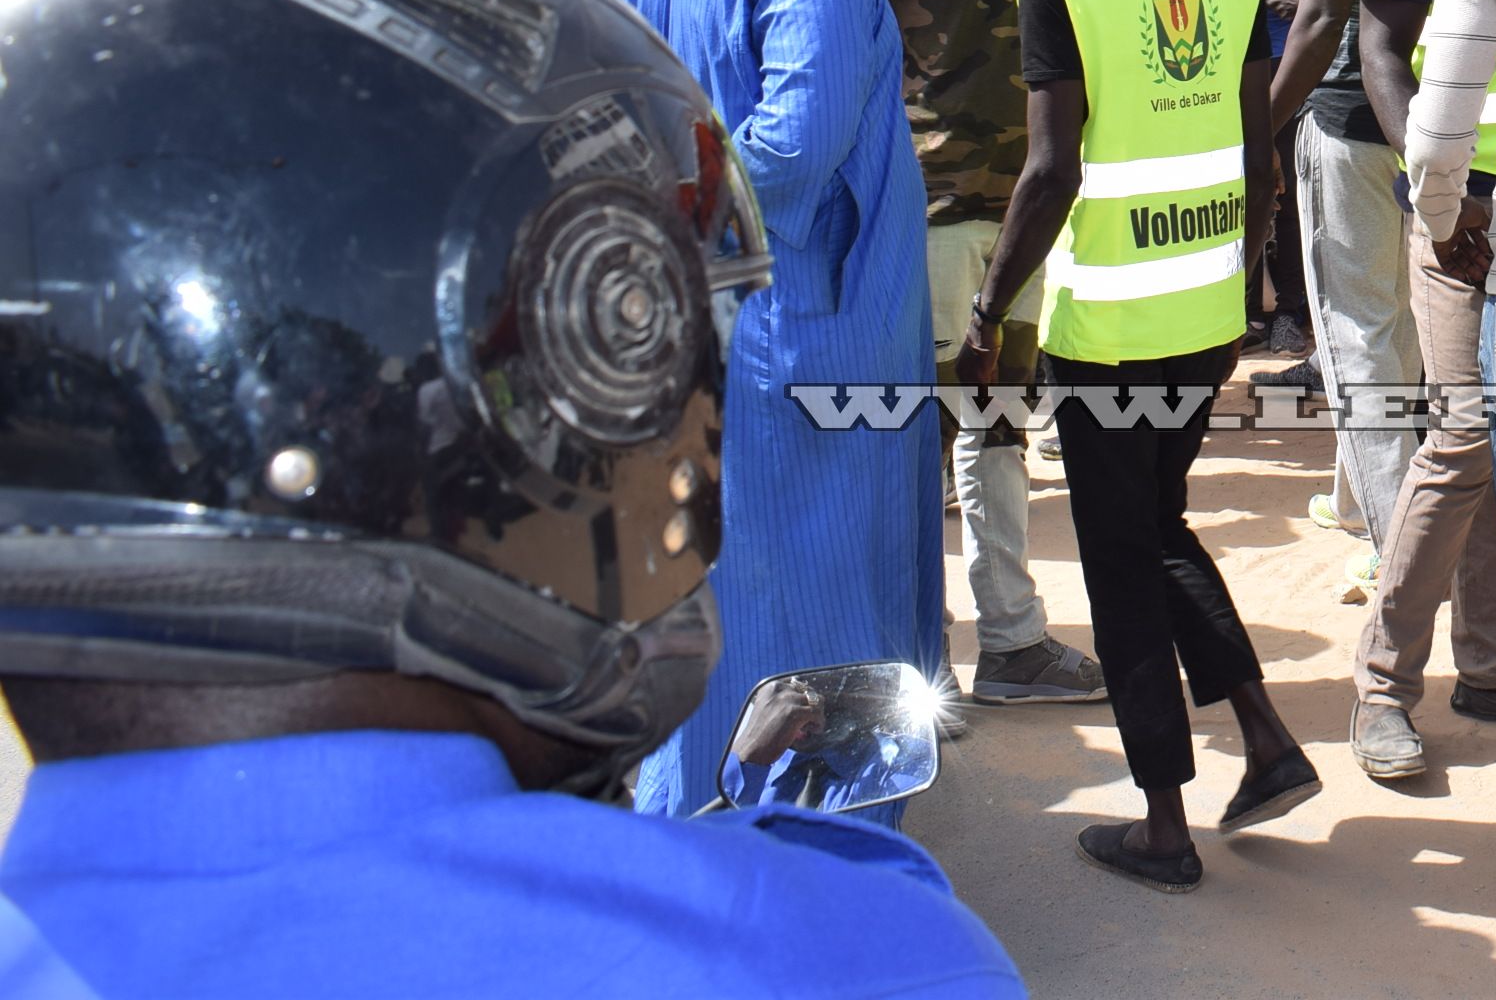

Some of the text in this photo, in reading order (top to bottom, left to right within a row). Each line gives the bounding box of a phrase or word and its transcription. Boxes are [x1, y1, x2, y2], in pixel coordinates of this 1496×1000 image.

[1151, 90, 1222, 113] Ville de Dakar
